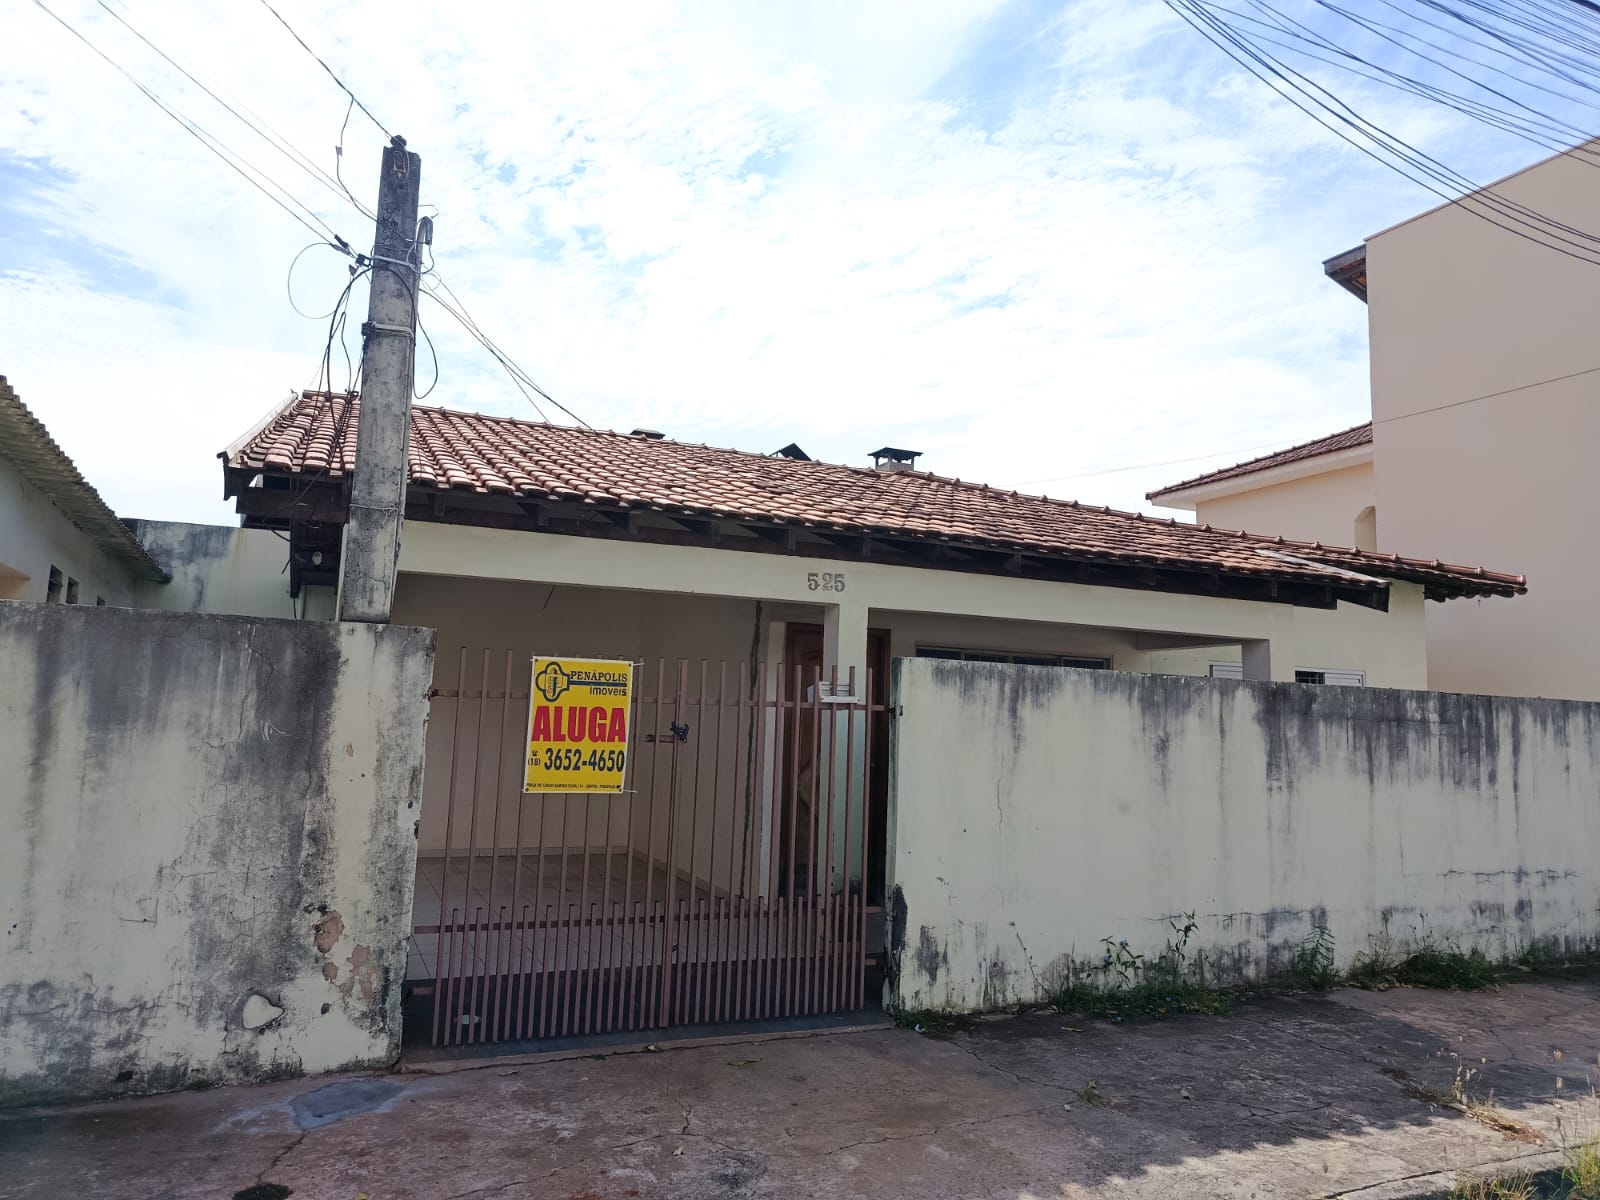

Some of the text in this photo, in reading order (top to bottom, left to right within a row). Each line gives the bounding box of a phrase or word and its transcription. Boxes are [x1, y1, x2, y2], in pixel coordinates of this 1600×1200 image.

[807, 572, 846, 593] 525
[570, 670, 628, 682] PENÁPOLIS
[531, 705, 626, 743] ALUGA
[527, 748, 625, 772] (18) 3652-4650
